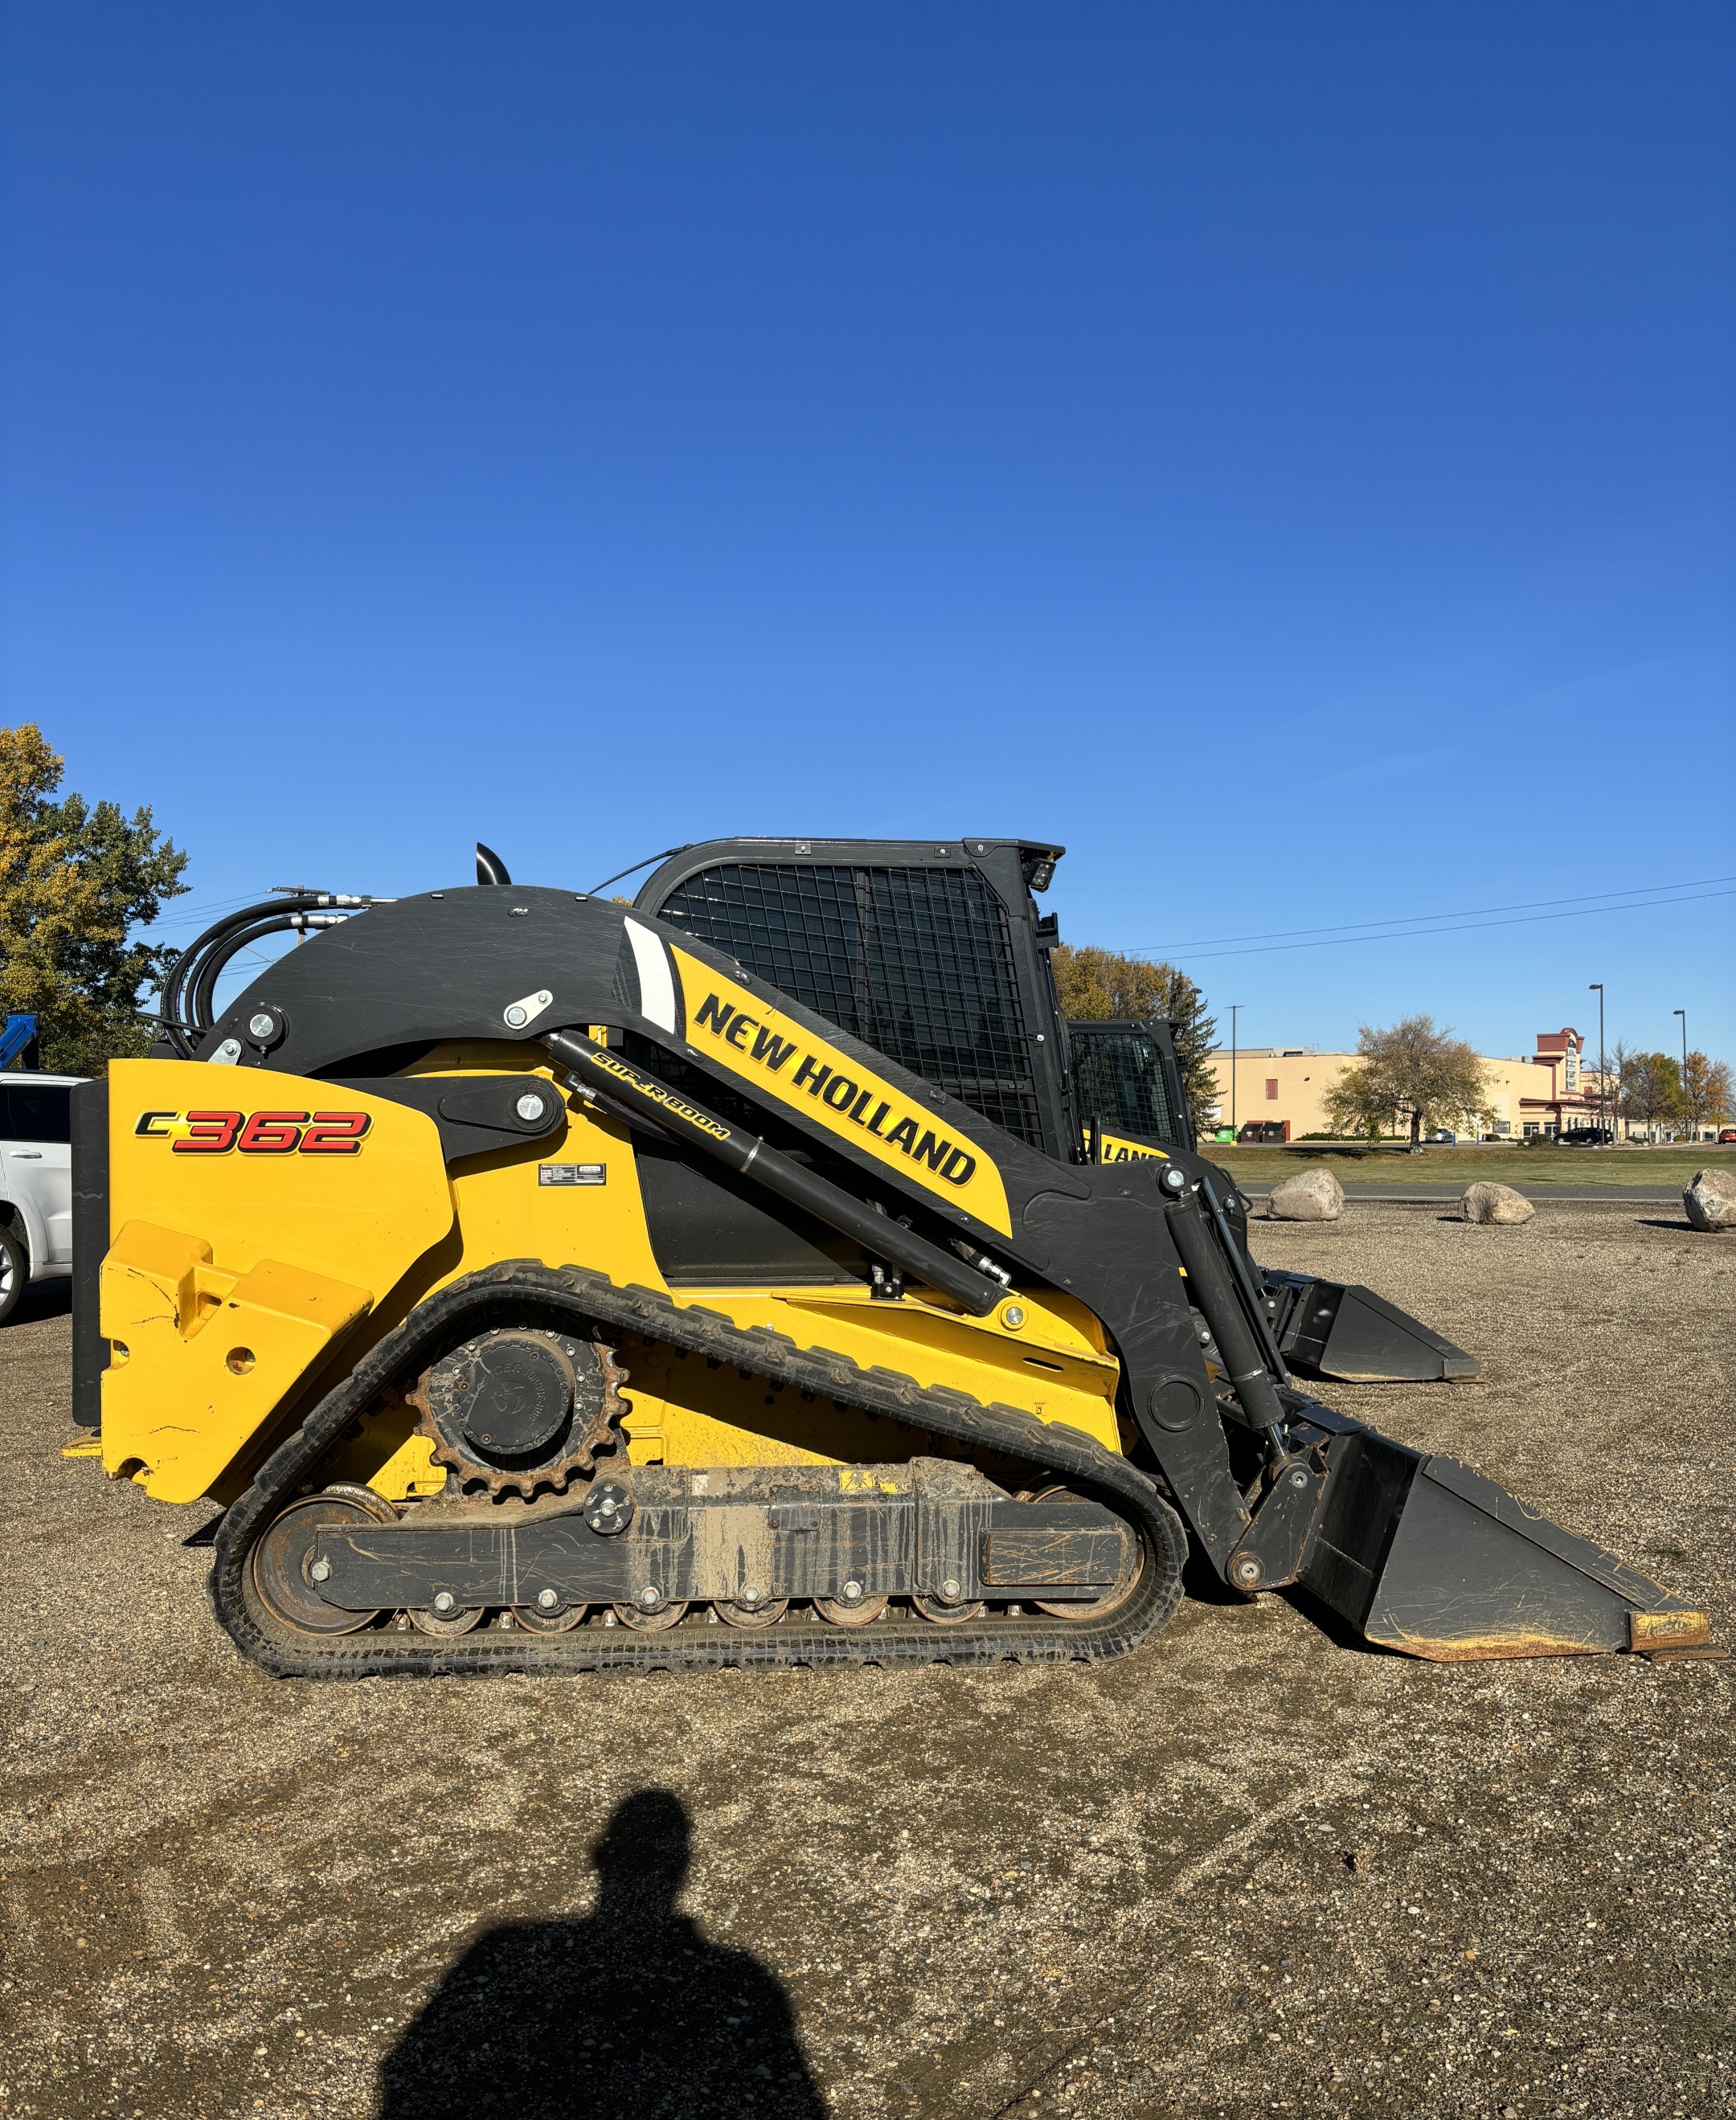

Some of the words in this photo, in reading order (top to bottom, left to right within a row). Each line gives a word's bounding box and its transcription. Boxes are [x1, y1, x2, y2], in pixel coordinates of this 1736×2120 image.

[591, 1053, 667, 1103] SUPER
[663, 1096, 731, 1141] BOOM
[694, 992, 798, 1073] NEW
[791, 1054, 977, 1187] HOLLAND
